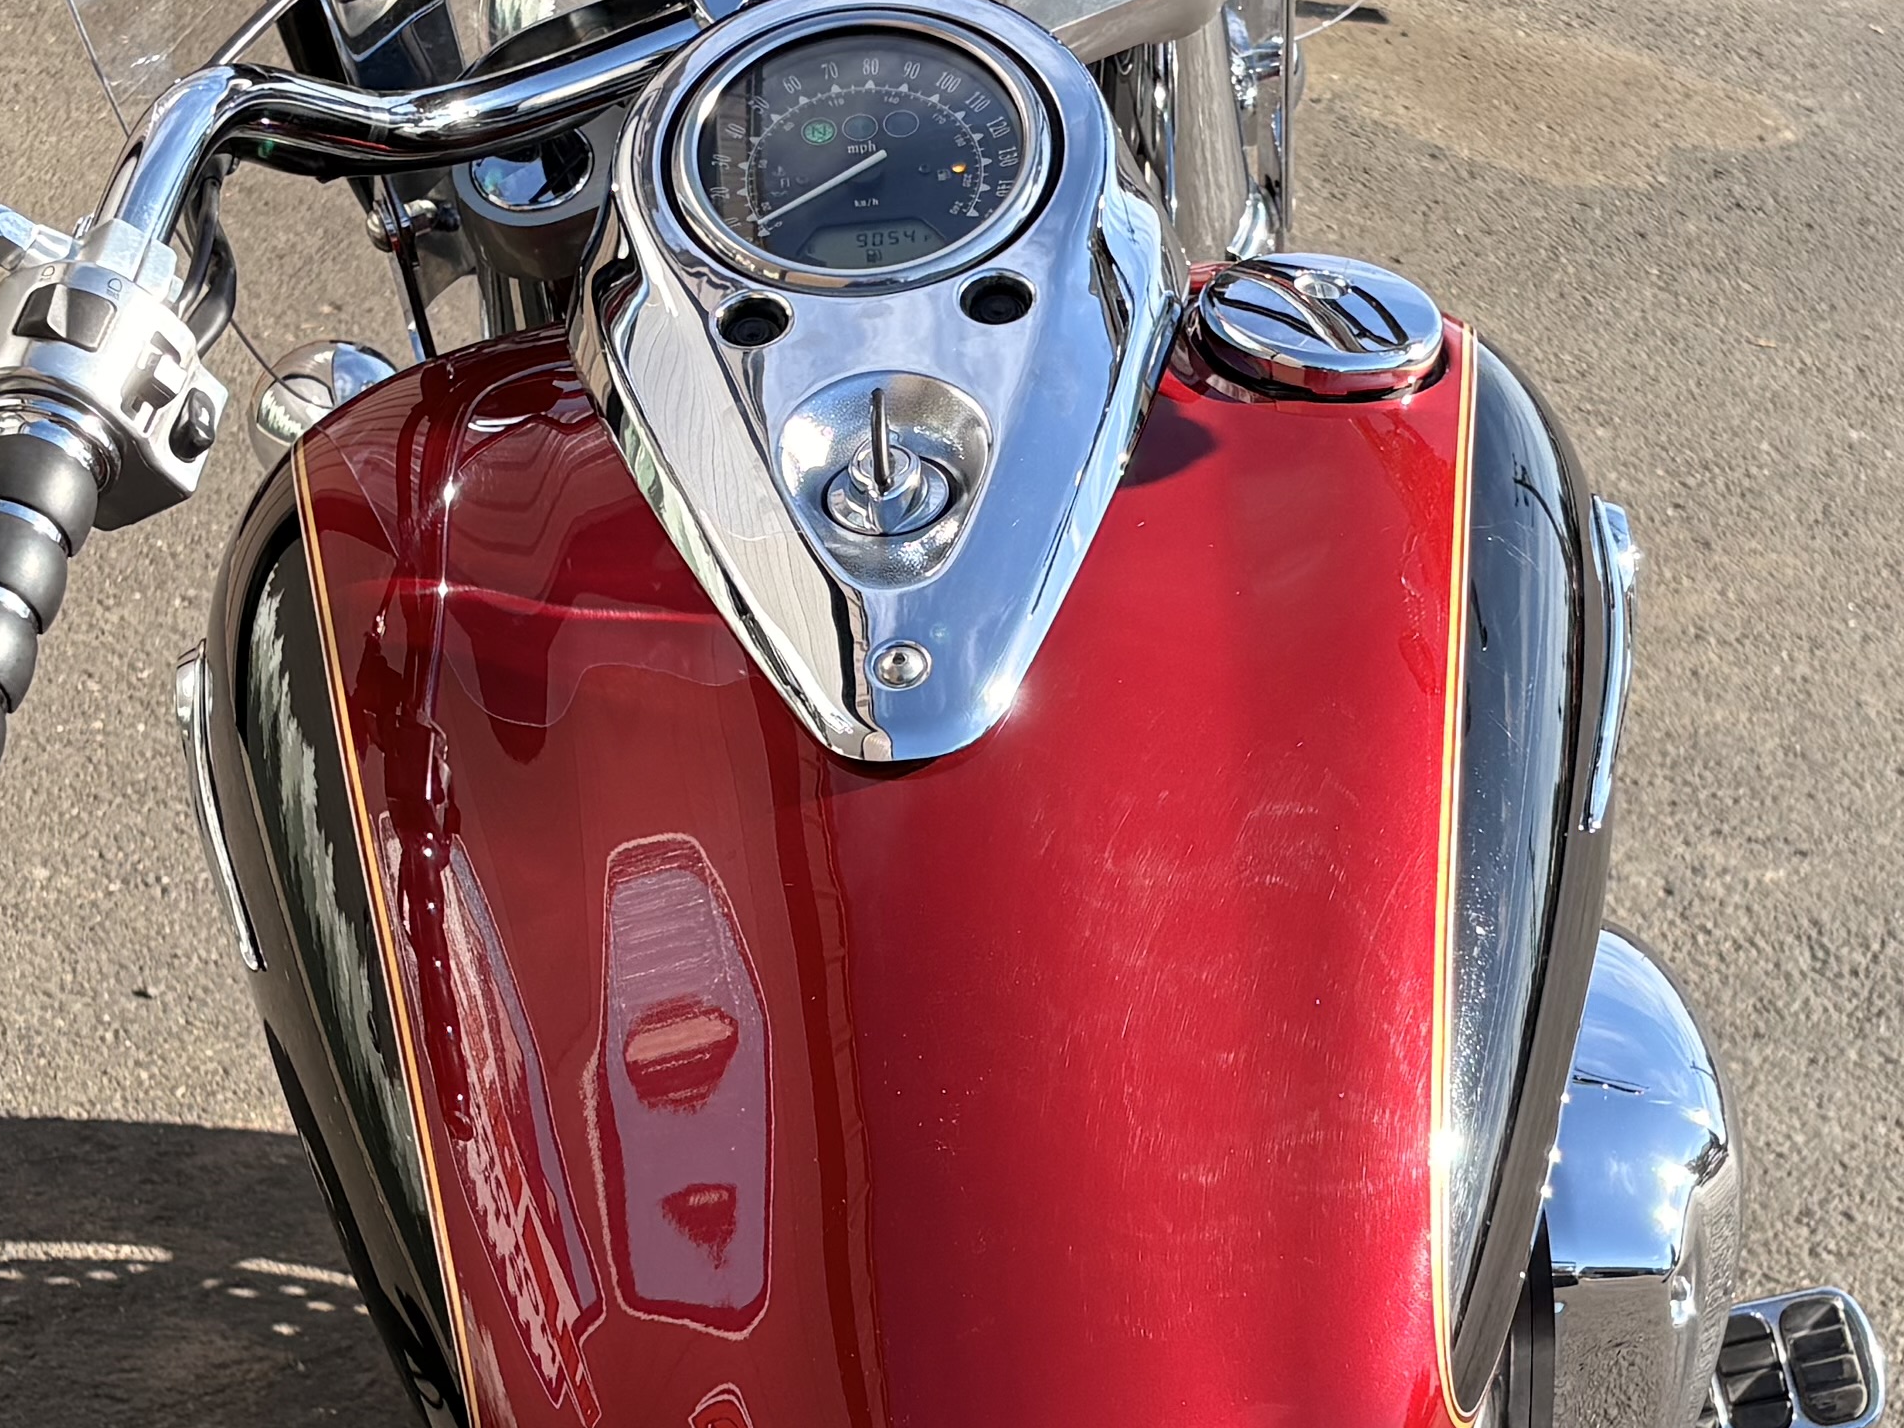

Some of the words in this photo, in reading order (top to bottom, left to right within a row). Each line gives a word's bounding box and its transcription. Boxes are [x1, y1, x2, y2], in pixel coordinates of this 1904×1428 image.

[821, 61, 839, 80] 70
[862, 58, 880, 76] 80
[903, 61, 921, 79] 90
[782, 76, 802, 94] 60
[935, 72, 962, 93] 100
[965, 91, 991, 113] 110
[986, 115, 1011, 139] 120
[848, 140, 877, 156] mph
[998, 146, 1019, 168] 130
[711, 154, 732, 171] 30
[856, 229, 916, 249] 9054
